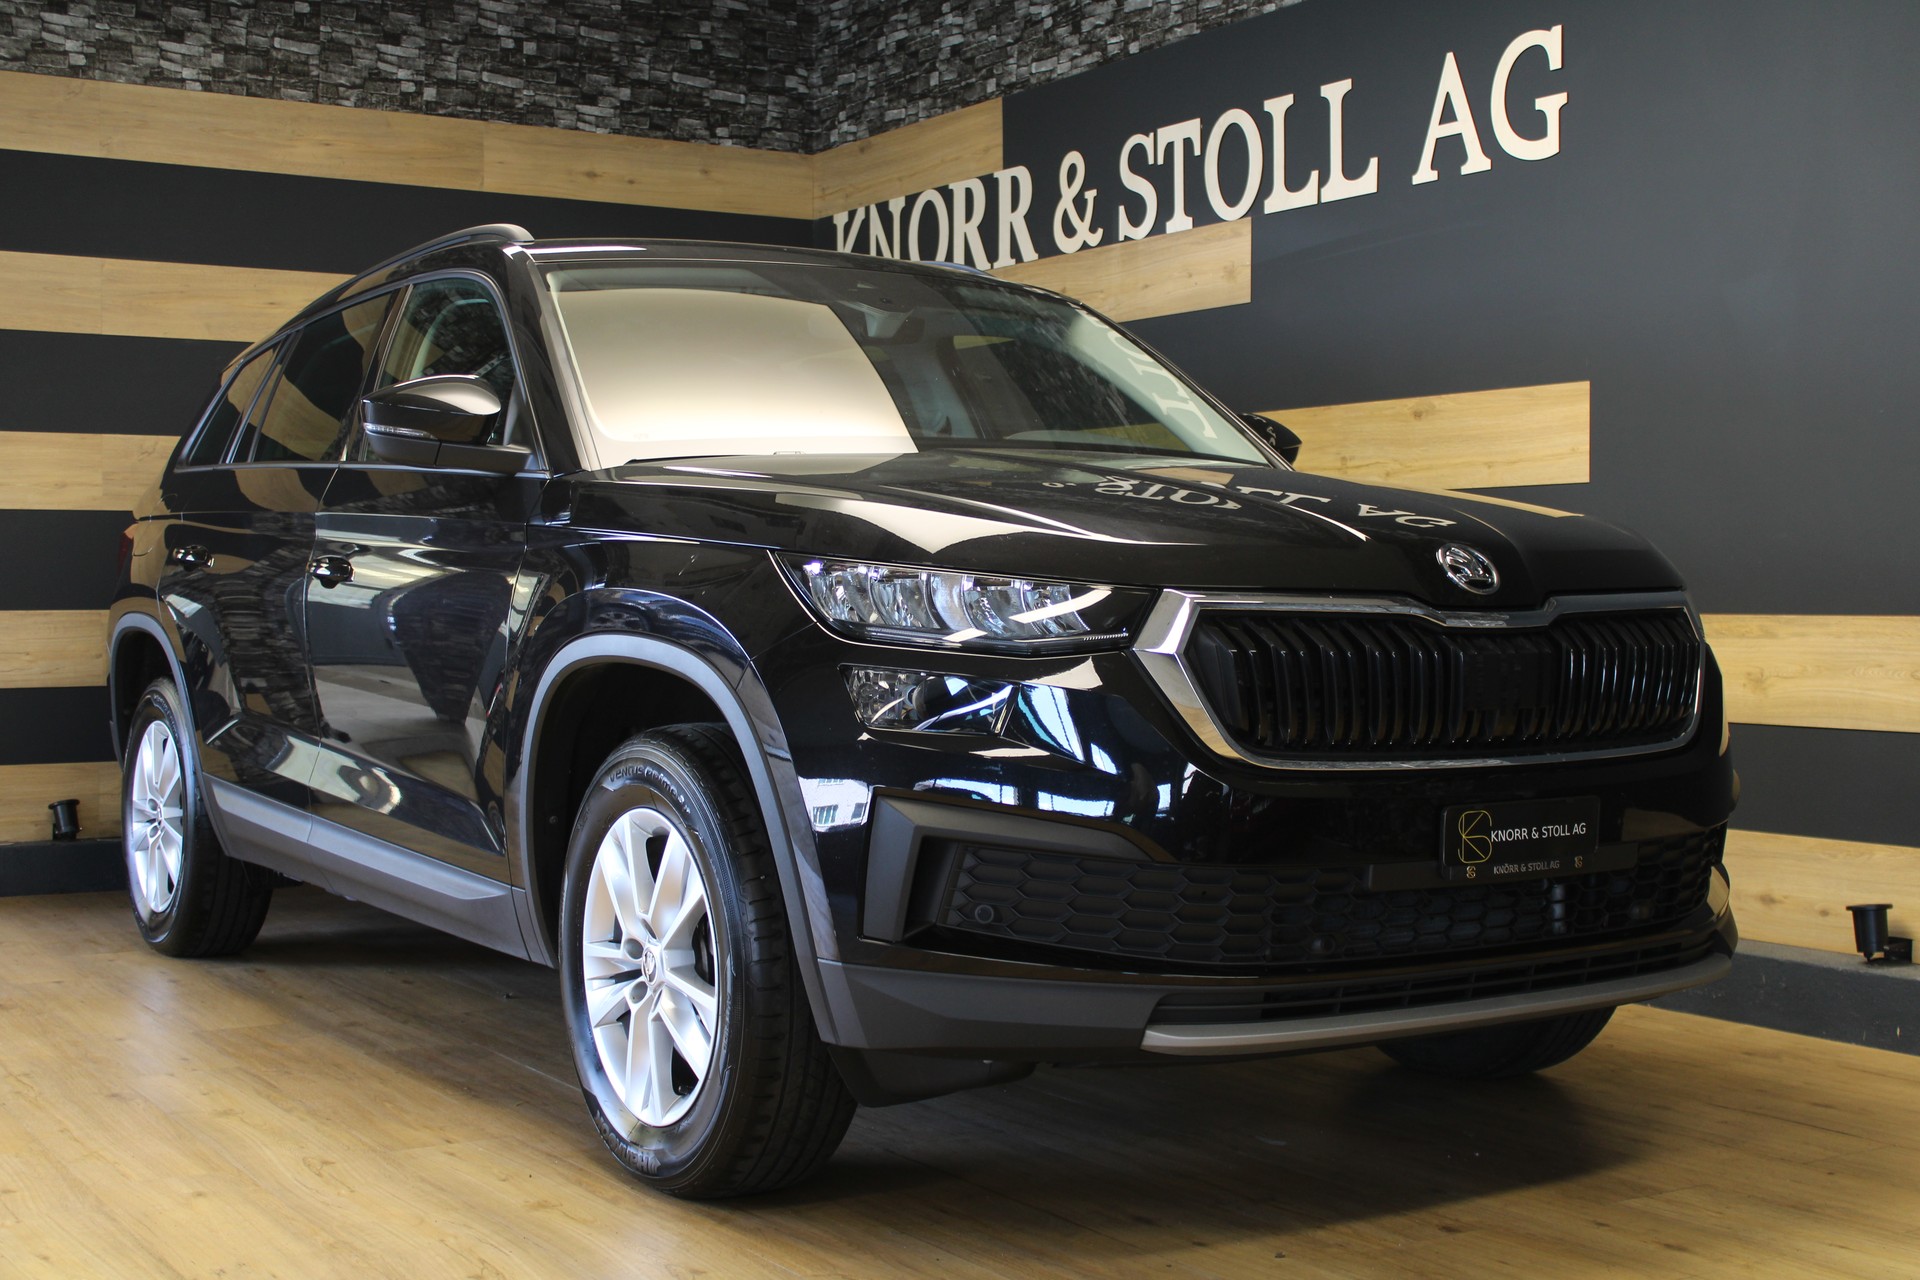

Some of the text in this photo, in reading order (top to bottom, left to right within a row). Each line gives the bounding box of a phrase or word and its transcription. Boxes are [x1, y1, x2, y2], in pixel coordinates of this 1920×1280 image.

[833, 24, 1568, 271] KNORR & STOLL AG
[1491, 822, 1586, 843] KNORR & STOLL AG
